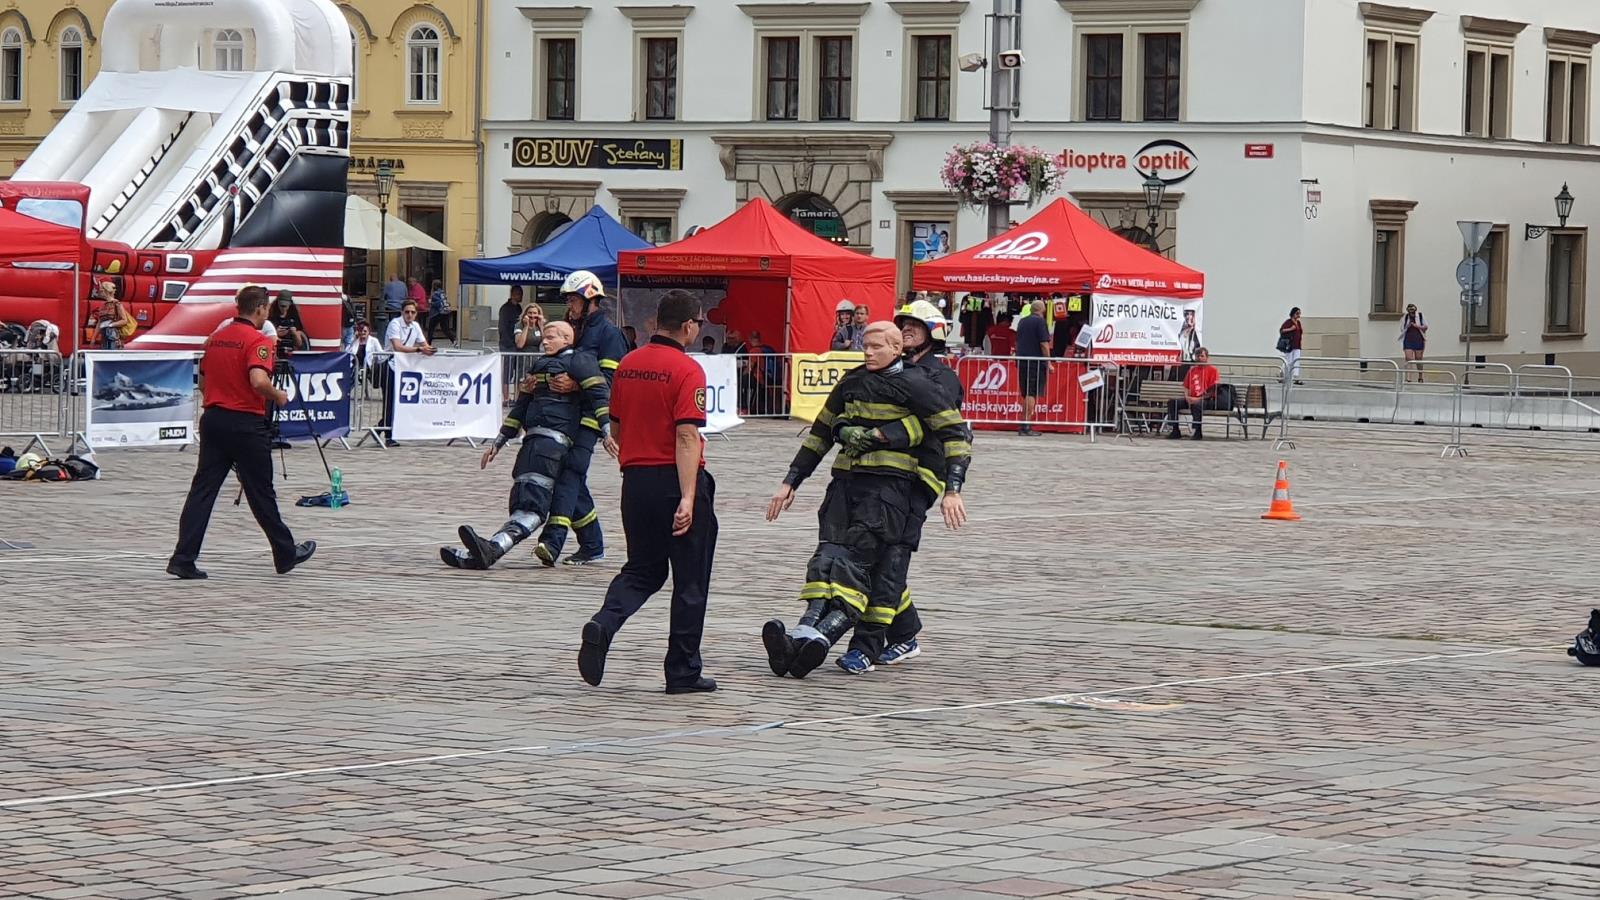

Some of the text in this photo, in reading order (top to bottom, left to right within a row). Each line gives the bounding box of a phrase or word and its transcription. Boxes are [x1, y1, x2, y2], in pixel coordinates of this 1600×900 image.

[515, 139, 594, 166] OBUV
[602, 141, 665, 168] Stefany
[1058, 149, 1190, 173] dioptra optik
[792, 207, 839, 218] Tamaris
[1097, 300, 1177, 320] VŠE PRO HASIČE
[1130, 331, 1148, 339] METAL
[803, 368, 849, 386] HAR
[457, 372, 492, 405] 211
[272, 410, 288, 421] ISS
[317, 411, 336, 420] s.r.o.
